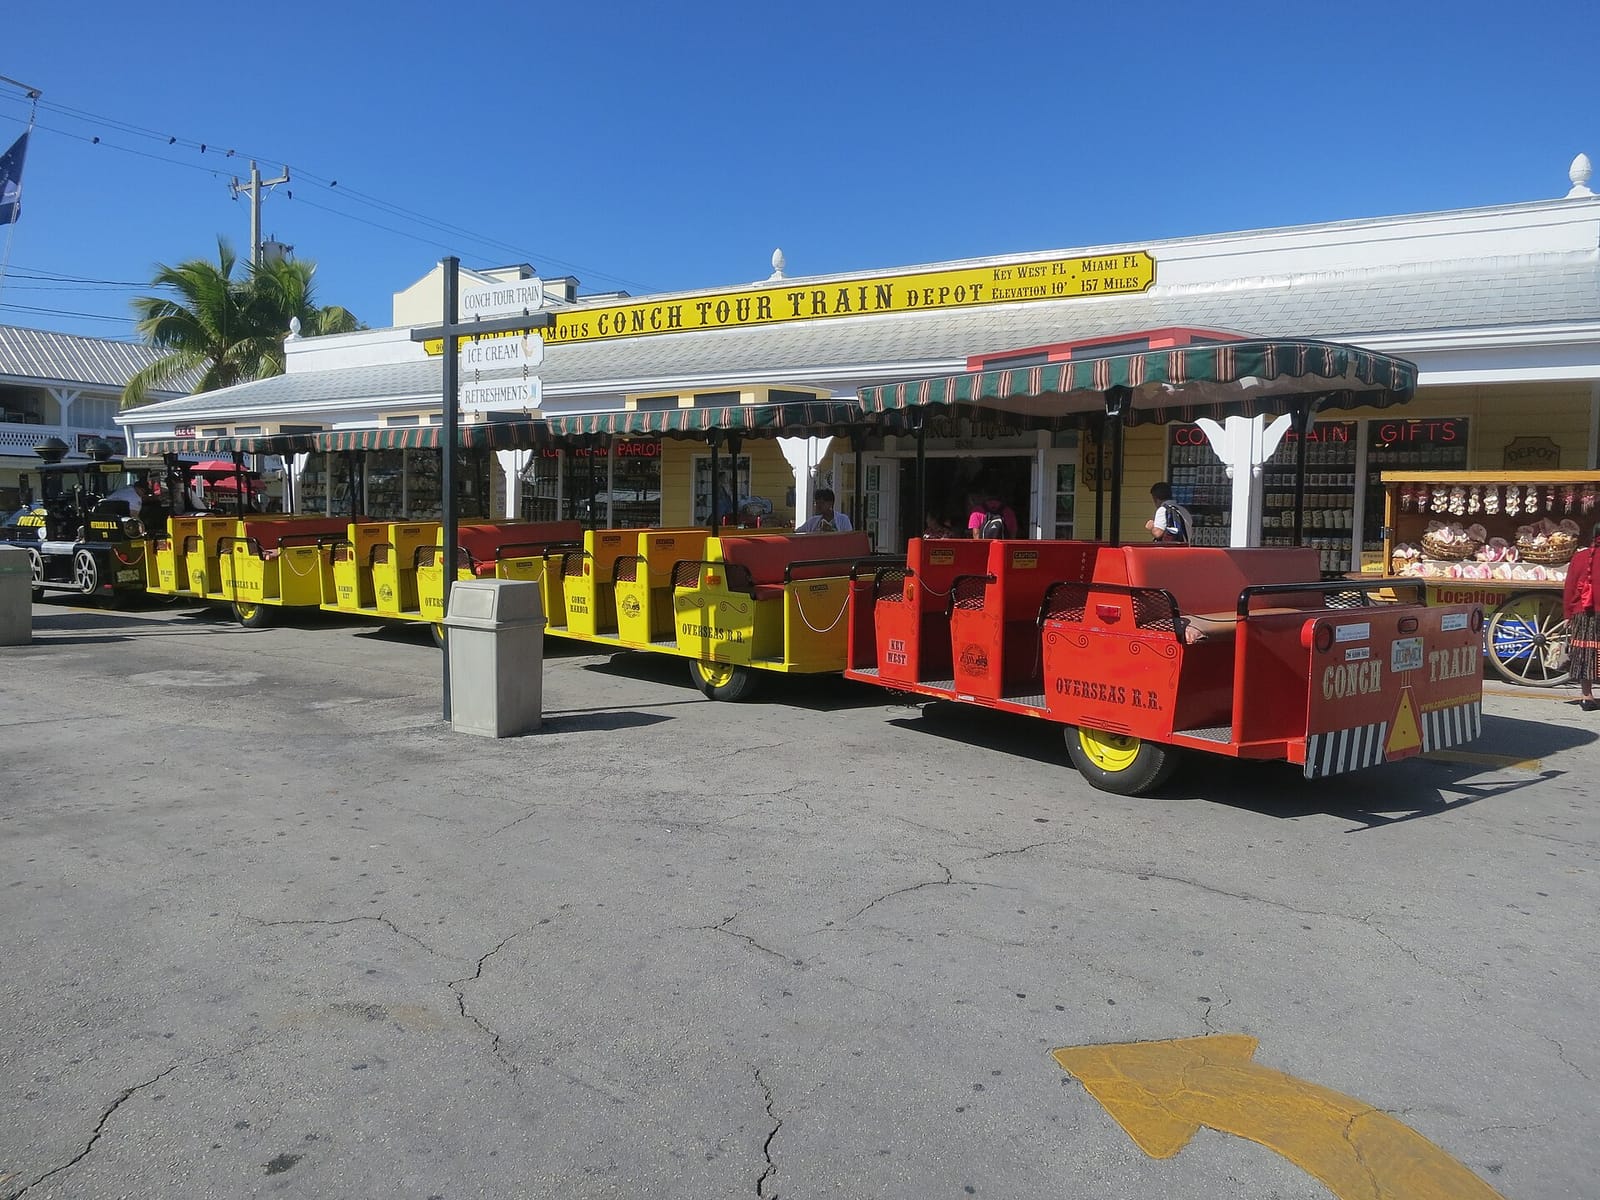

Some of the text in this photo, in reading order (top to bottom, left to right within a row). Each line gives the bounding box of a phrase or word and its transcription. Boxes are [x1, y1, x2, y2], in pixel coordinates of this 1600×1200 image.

[993, 263, 1066, 281] KEY WEST FL
[1082, 255, 1138, 273] MIAMI FL
[992, 285, 1046, 299] ELEVATION
[1081, 277, 1138, 292] 157 MILES
[465, 285, 540, 310] CONCH TOUR TRAIN
[598, 305, 682, 335] CONCH
[696, 295, 773, 325] TOUR
[787, 283, 893, 316] TRAIN
[906, 283, 983, 307] DEPOT
[468, 343, 518, 364] ICE CREAM
[465, 385, 528, 404] REFRESHMENTS
[1379, 421, 1456, 443] GIFTS
[682, 623, 724, 641] OVERSEAS
[891, 640, 904, 651] KEY
[887, 652, 906, 664] WEST
[1322, 660, 1382, 700] CONCH
[1428, 645, 1479, 683] TRAIN
[1056, 677, 1163, 711] OVERSEAS R.R.
